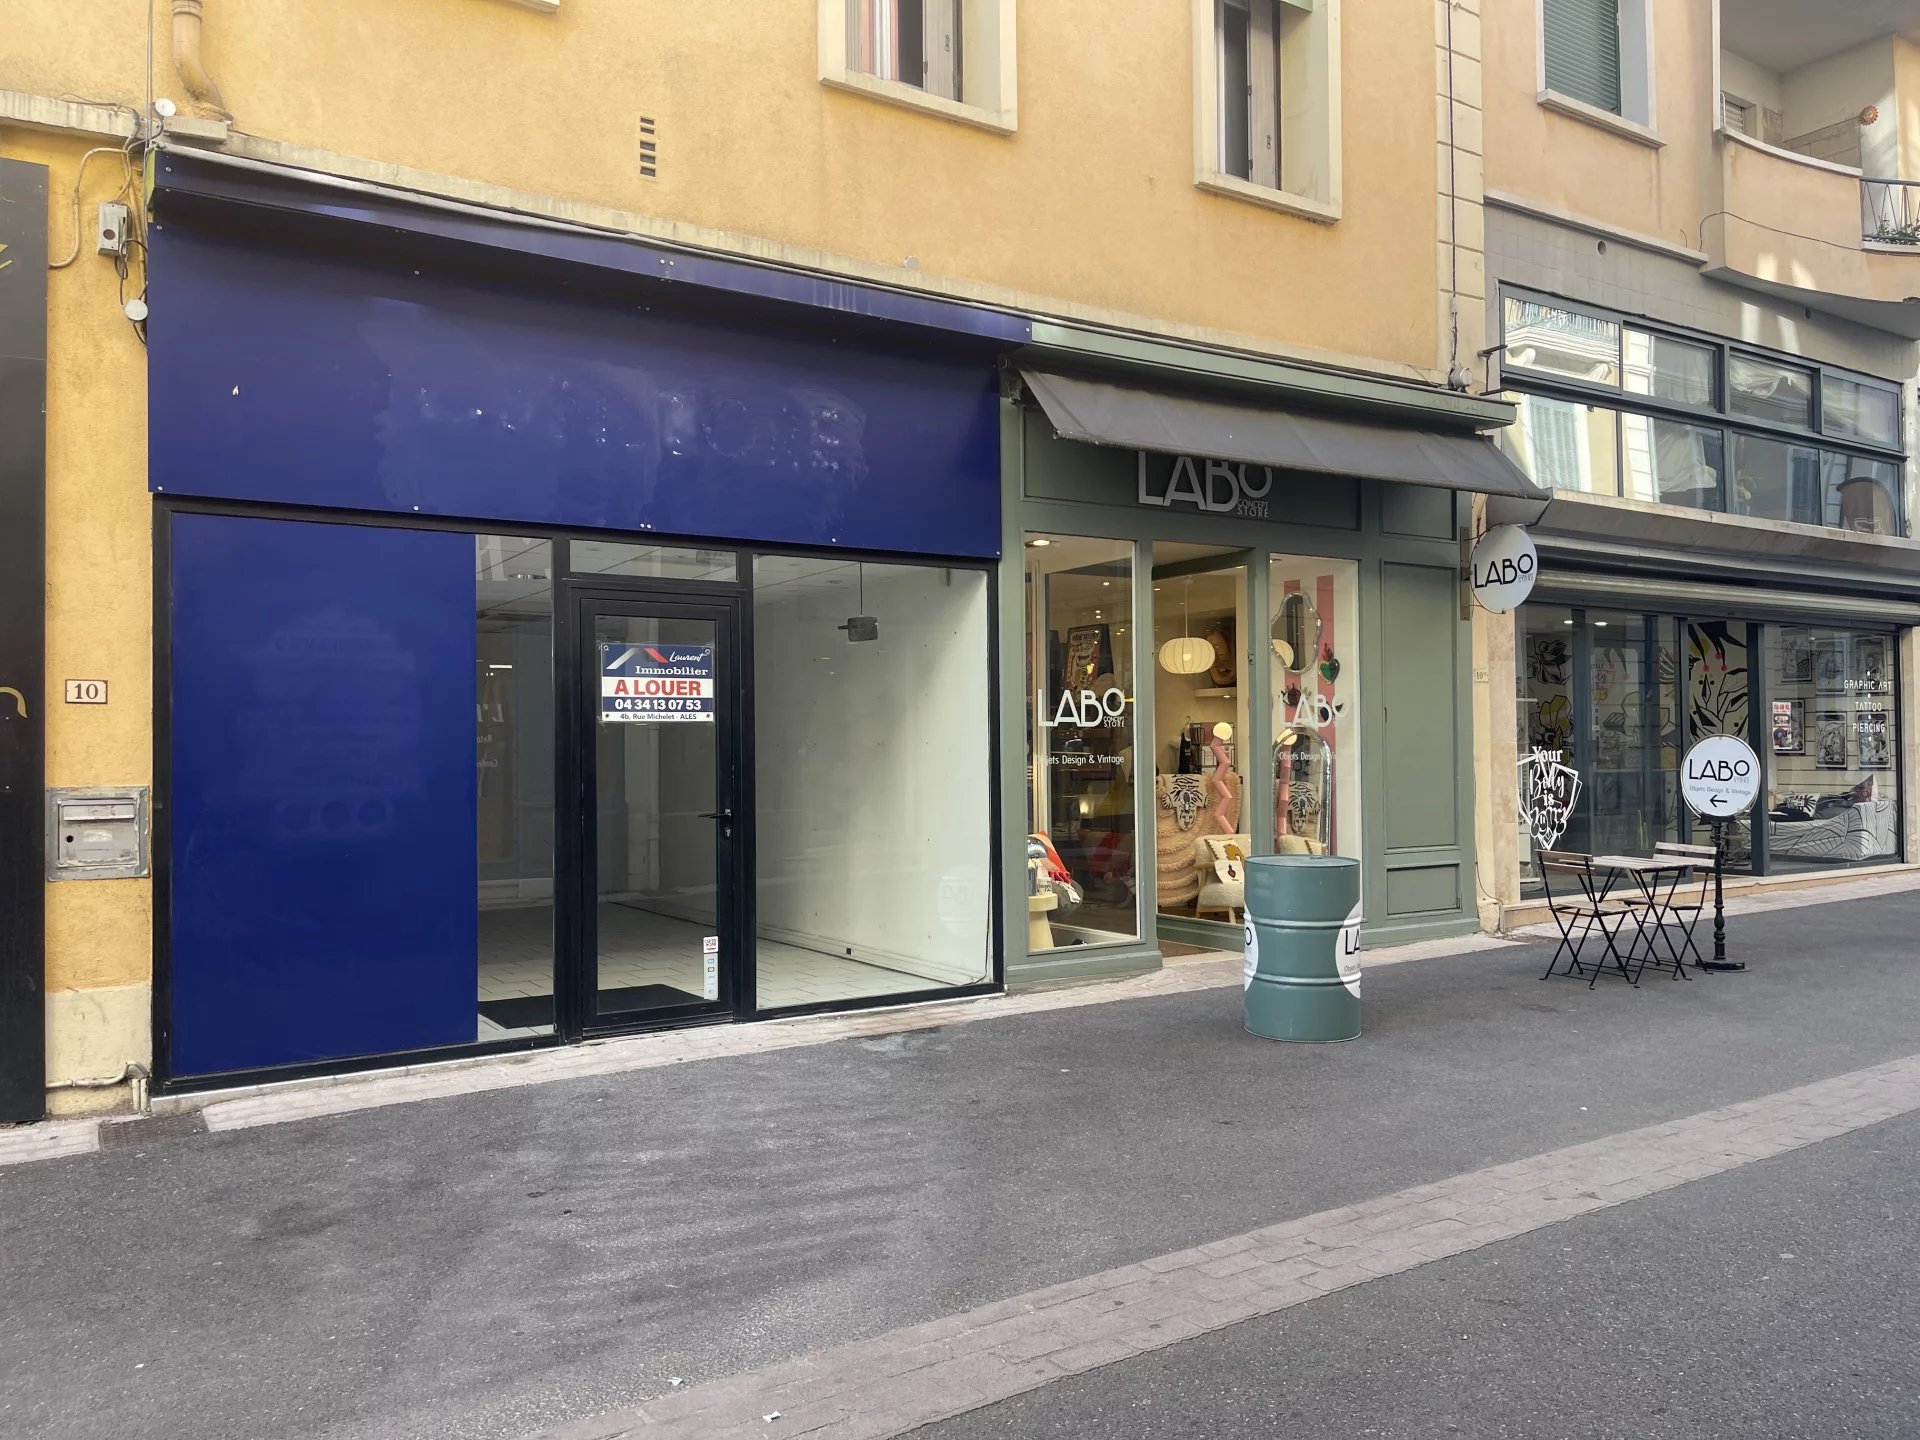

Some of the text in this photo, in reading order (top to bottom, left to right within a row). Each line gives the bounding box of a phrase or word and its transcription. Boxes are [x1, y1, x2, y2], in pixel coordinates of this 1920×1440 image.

[1138, 451, 1273, 512] LABO
[1237, 507, 1269, 518] STORE
[1474, 553, 1534, 589] LABO
[669, 651, 707, 662] Laurent
[635, 665, 708, 675] Immobilier
[75, 683, 99, 700] 10
[614, 680, 702, 696] A LOUER
[1844, 680, 1891, 691] GRAPHIC ART
[615, 699, 701, 710] 04 34 13 07 53
[1038, 687, 1125, 727] LABO
[1280, 693, 1350, 728] LABO
[1855, 701, 1882, 711] TATTOO
[1853, 723, 1886, 733] PIERCING
[1062, 755, 1086, 766] Design
[1088, 754, 1095, 764] &
[1097, 754, 1125, 765] Vintage
[1532, 746, 1563, 763] Your
[1689, 758, 1750, 781] LABO
[1543, 789, 1554, 806] is
